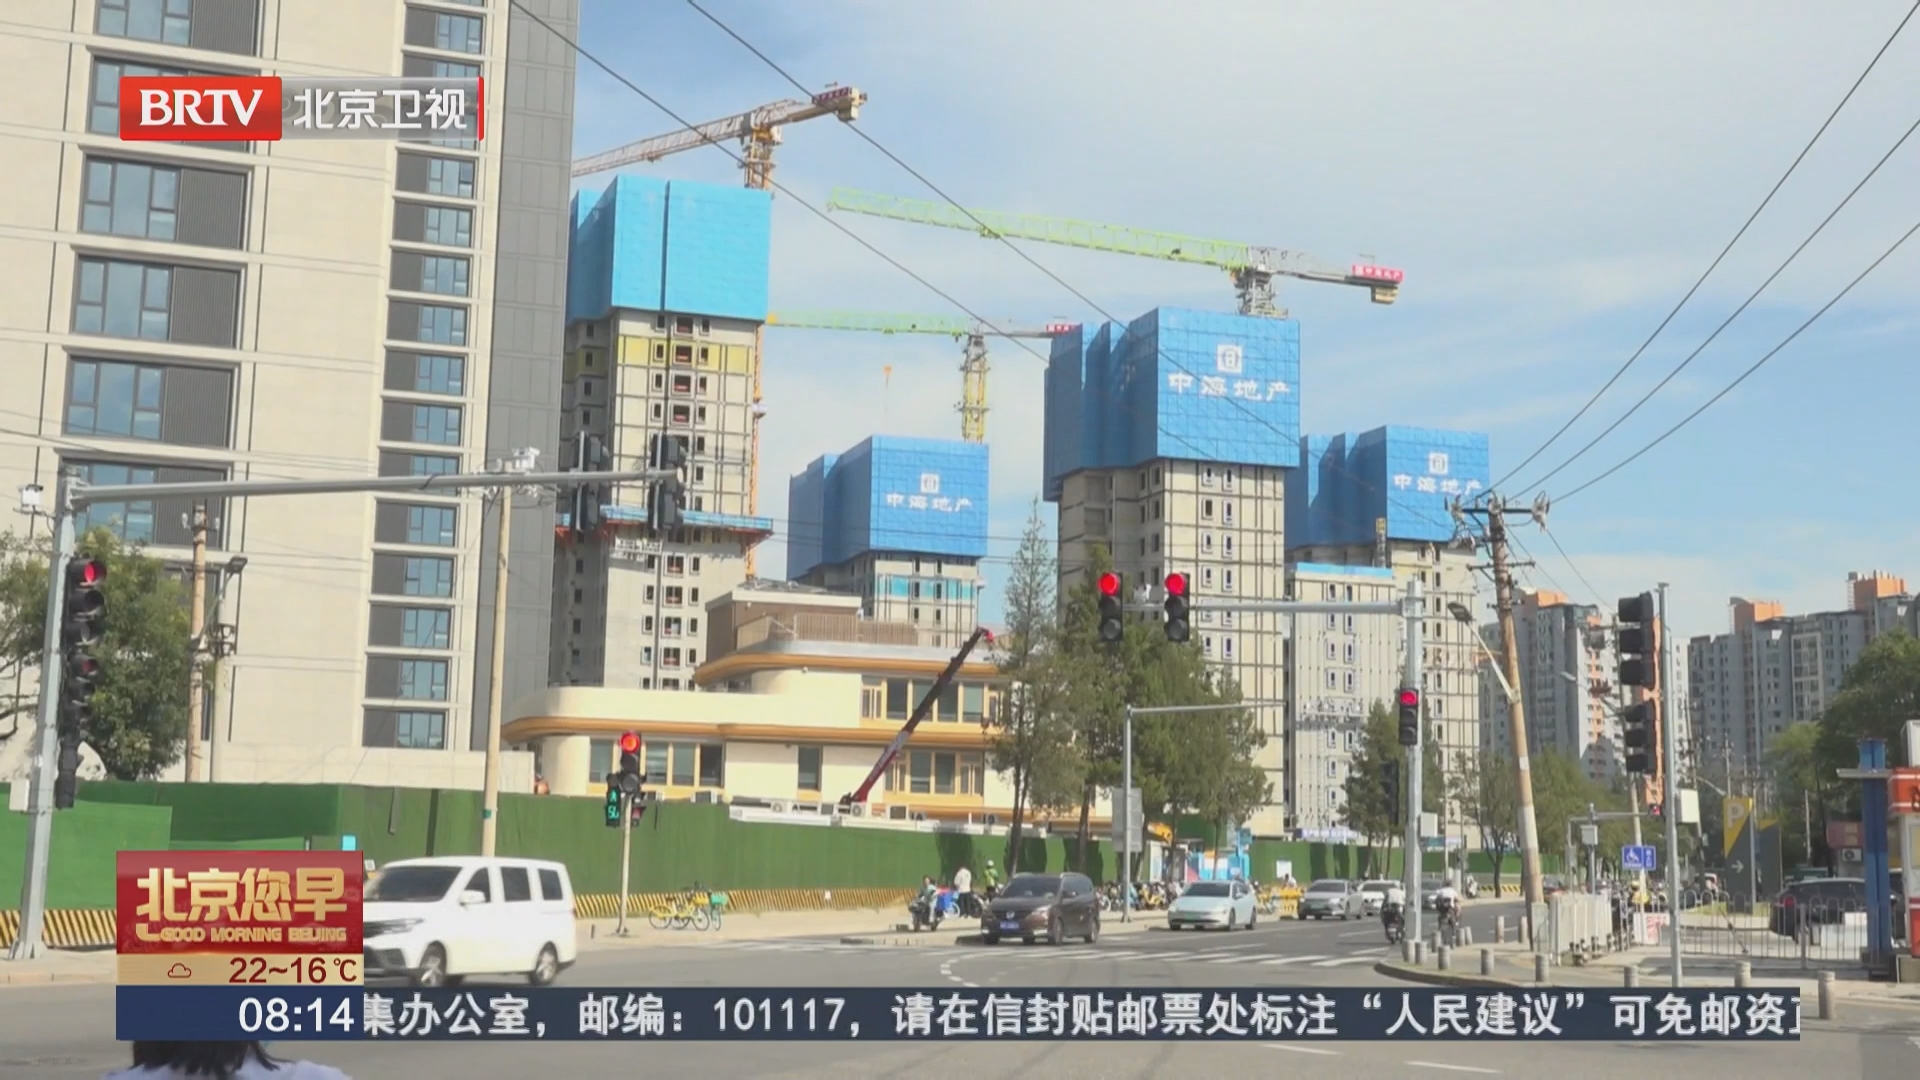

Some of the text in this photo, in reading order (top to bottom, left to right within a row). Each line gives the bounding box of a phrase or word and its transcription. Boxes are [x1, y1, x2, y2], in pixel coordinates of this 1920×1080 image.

[1168, 373, 1290, 401] 中海地产
[1393, 474, 1482, 496] 中海地产
[886, 493, 973, 512] 中海地产
